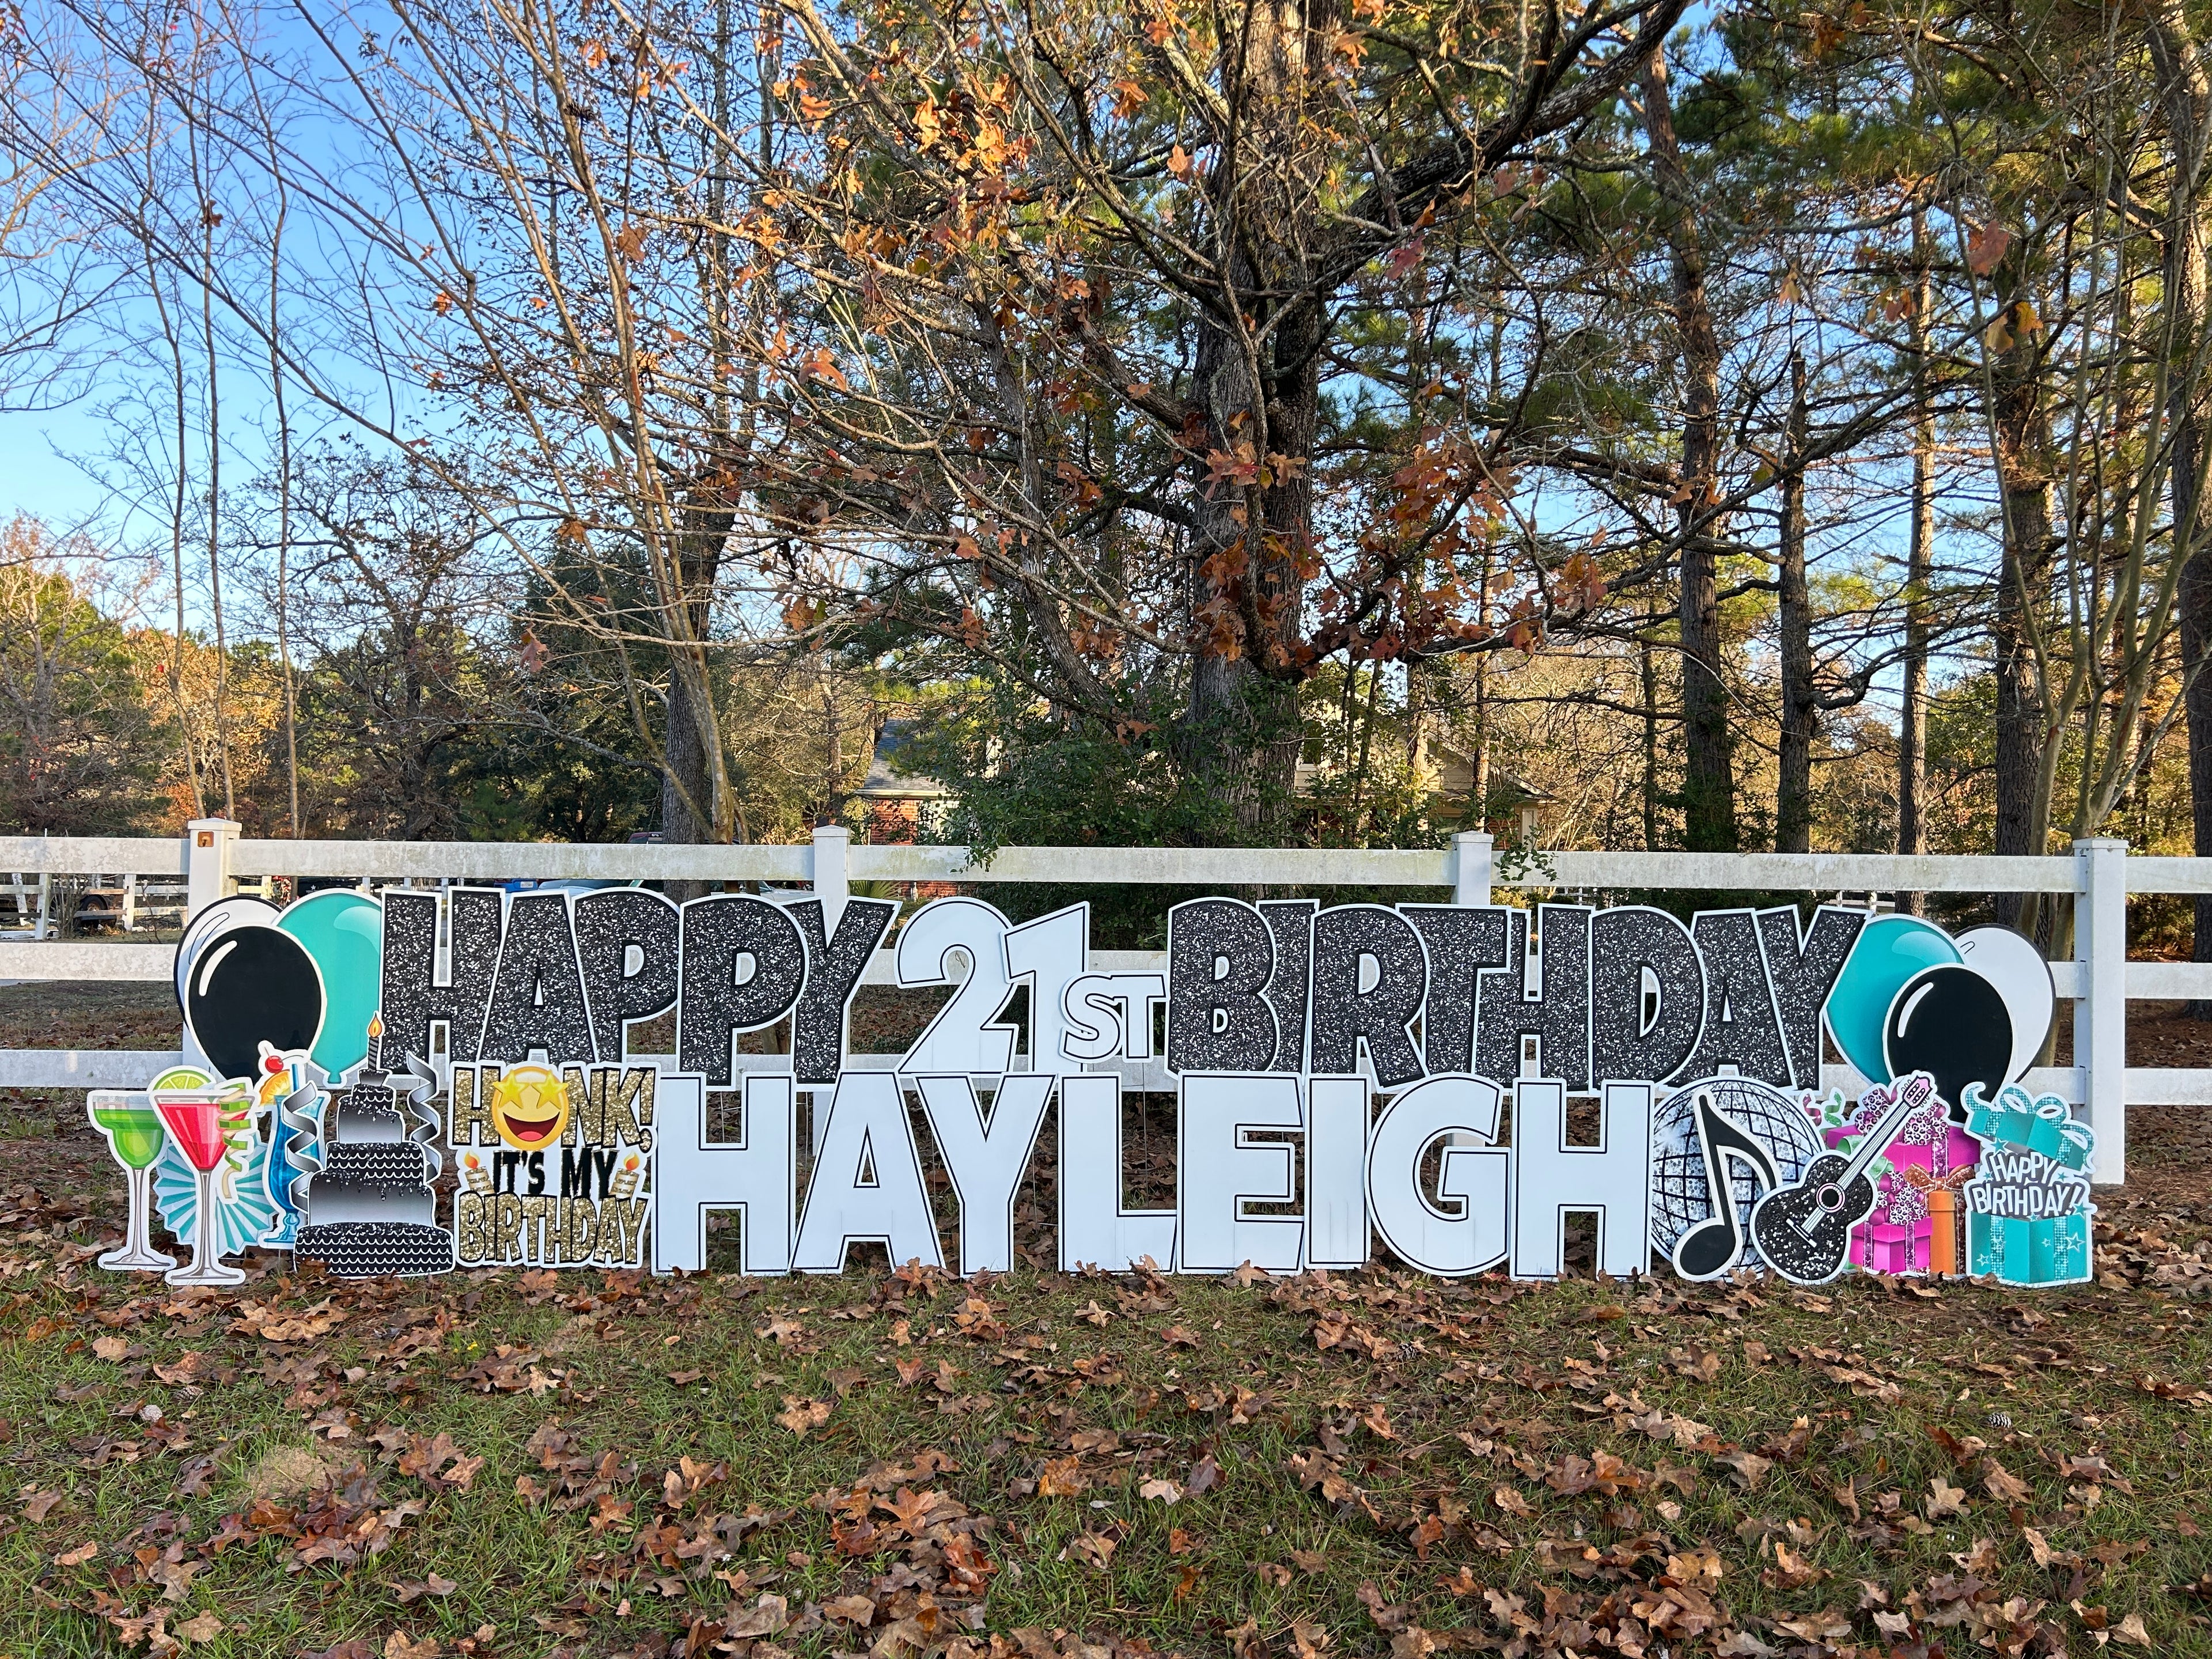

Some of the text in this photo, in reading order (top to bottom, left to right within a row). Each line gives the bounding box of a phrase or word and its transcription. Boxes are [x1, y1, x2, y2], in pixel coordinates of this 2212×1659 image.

[382, 890, 896, 1089] HAPPY
[1168, 899, 1865, 1090] BIRTHDAY
[493, 1149, 619, 1200] IT'S MY
[656, 1074, 1653, 1277] HAYLEIGH
[1990, 1152, 2058, 1184] HAPPY
[459, 1191, 649, 1264] BIRTHDAY
[1972, 1183, 2082, 1217] BIRTHDAY!
